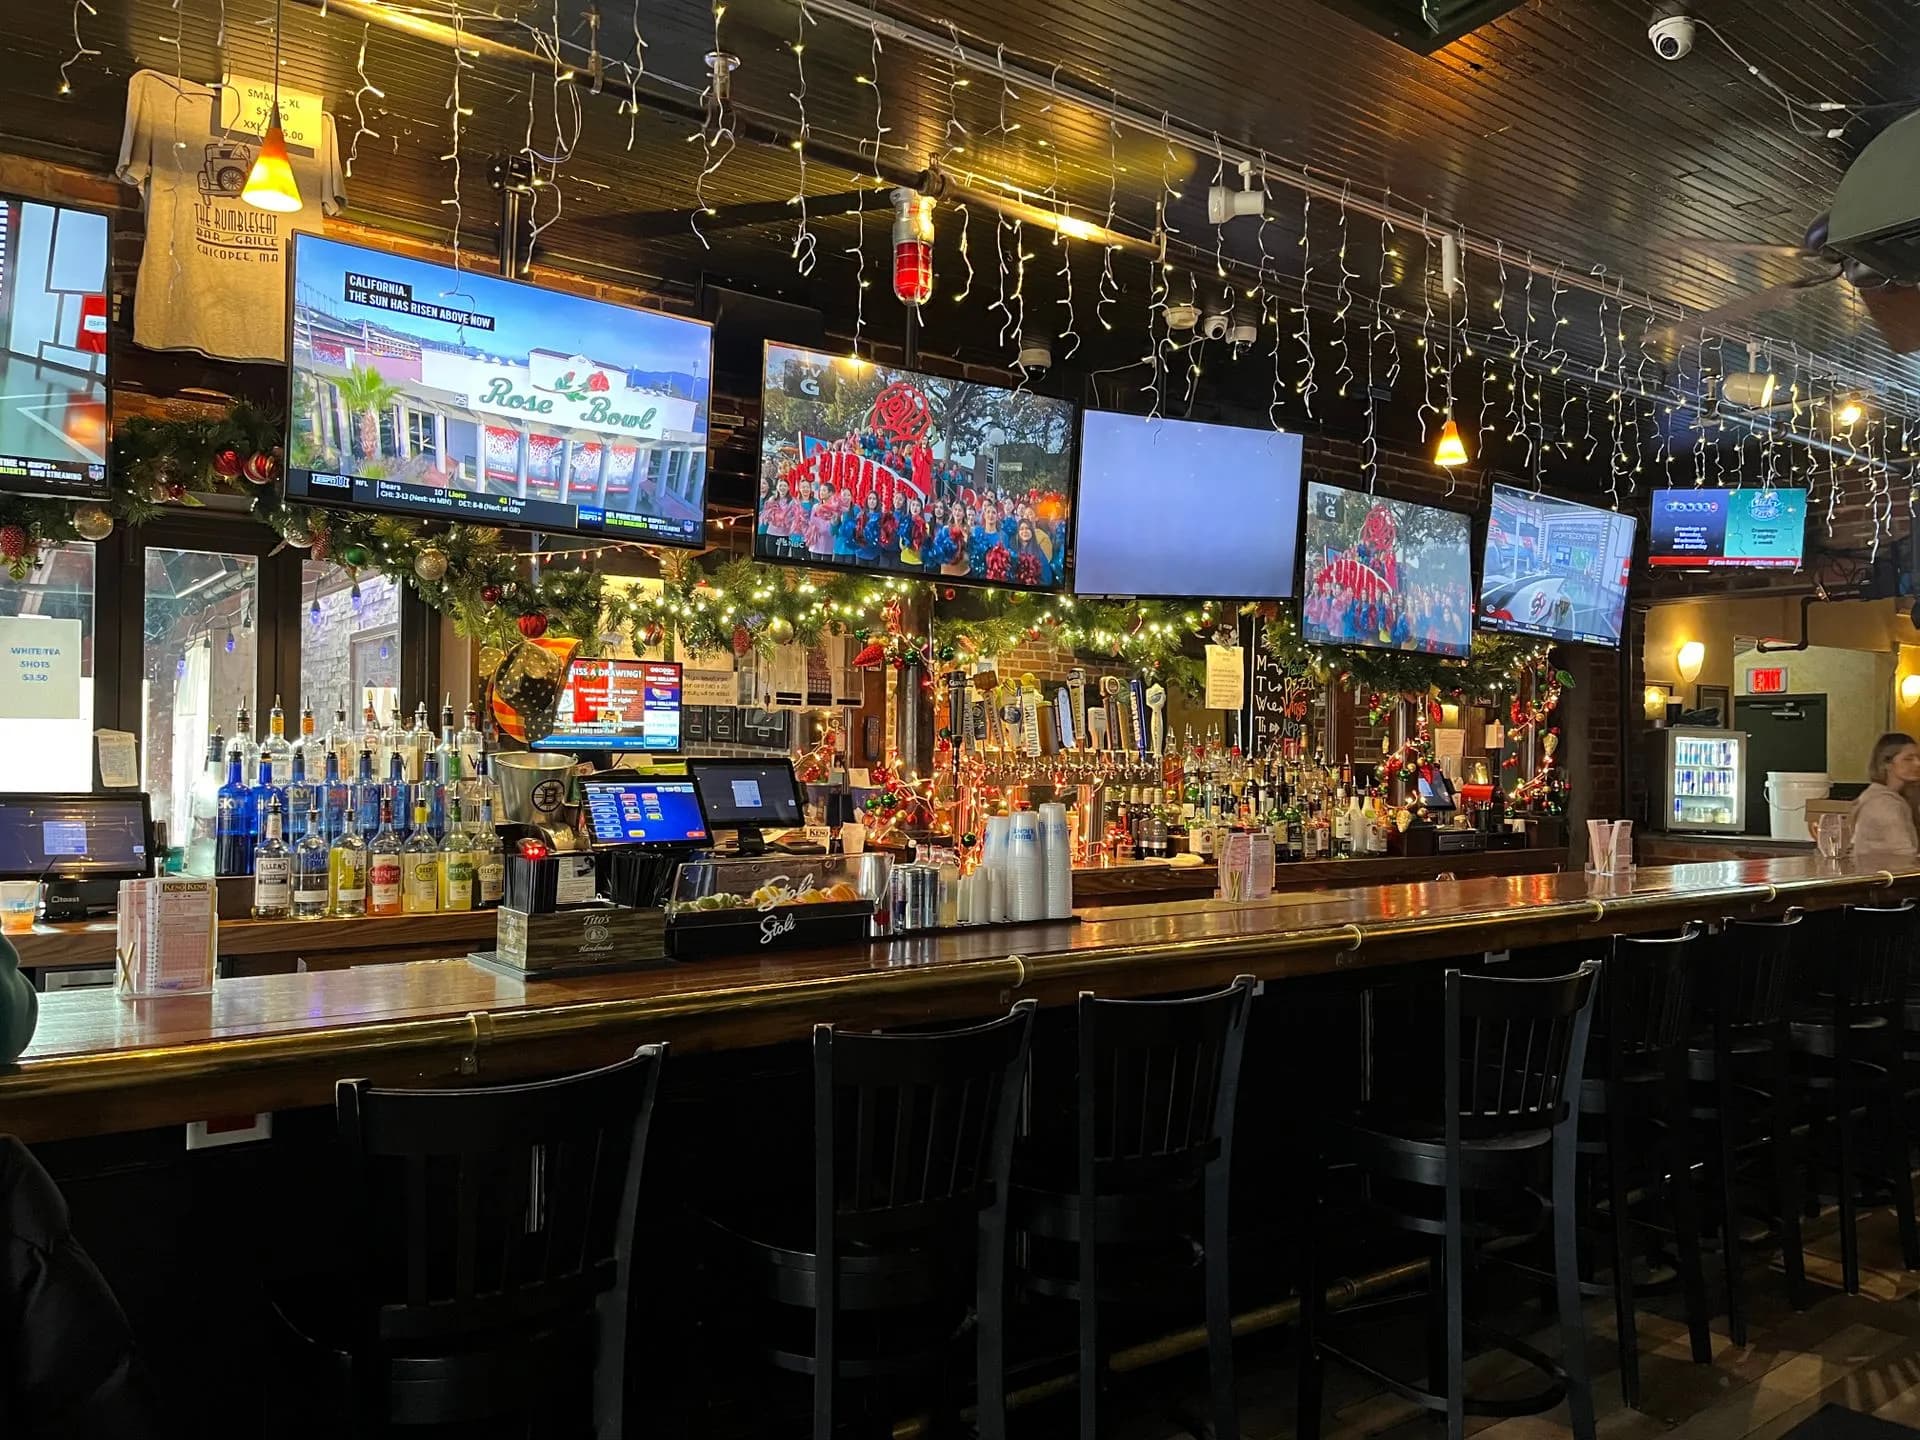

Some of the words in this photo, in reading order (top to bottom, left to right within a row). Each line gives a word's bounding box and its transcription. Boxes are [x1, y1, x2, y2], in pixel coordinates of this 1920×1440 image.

[289, 98, 301, 109] XL
[194, 203, 211, 227] THE
[214, 207, 278, 236] RUMBLESEAT
[196, 227, 220, 242] BAR
[235, 235, 278, 247] GRILLE
[259, 252, 279, 263] MA
[349, 274, 408, 297] CALIFORNIA.
[349, 289, 367, 304] THE
[369, 294, 389, 308] SUN
[390, 298, 409, 312] HAS
[410, 302, 438, 317] RISEN
[439, 309, 469, 325] ABOVE
[470, 314, 491, 329] NOW
[800, 366, 821, 378] TV
[800, 378, 820, 396] G
[478, 377, 554, 414] Rose
[579, 396, 658, 431] Bowl
[380, 481, 402, 491] Bears
[434, 488, 444, 496] 10
[447, 489, 467, 499] Lions
[1325, 495, 1337, 504] TV
[1324, 506, 1336, 518] G
[10, 647, 42, 655] WHITE
[19, 660, 50, 668] SHOTS
[1256, 654, 1267, 672] M
[598, 668, 642, 679] DRAWING!
[164, 883, 186, 891] KENO
[187, 883, 208, 891] KENO
[757, 873, 814, 912] Stoli
[60, 895, 80, 903] toast
[583, 914, 611, 926] Tito's
[759, 912, 796, 944] Stoli
